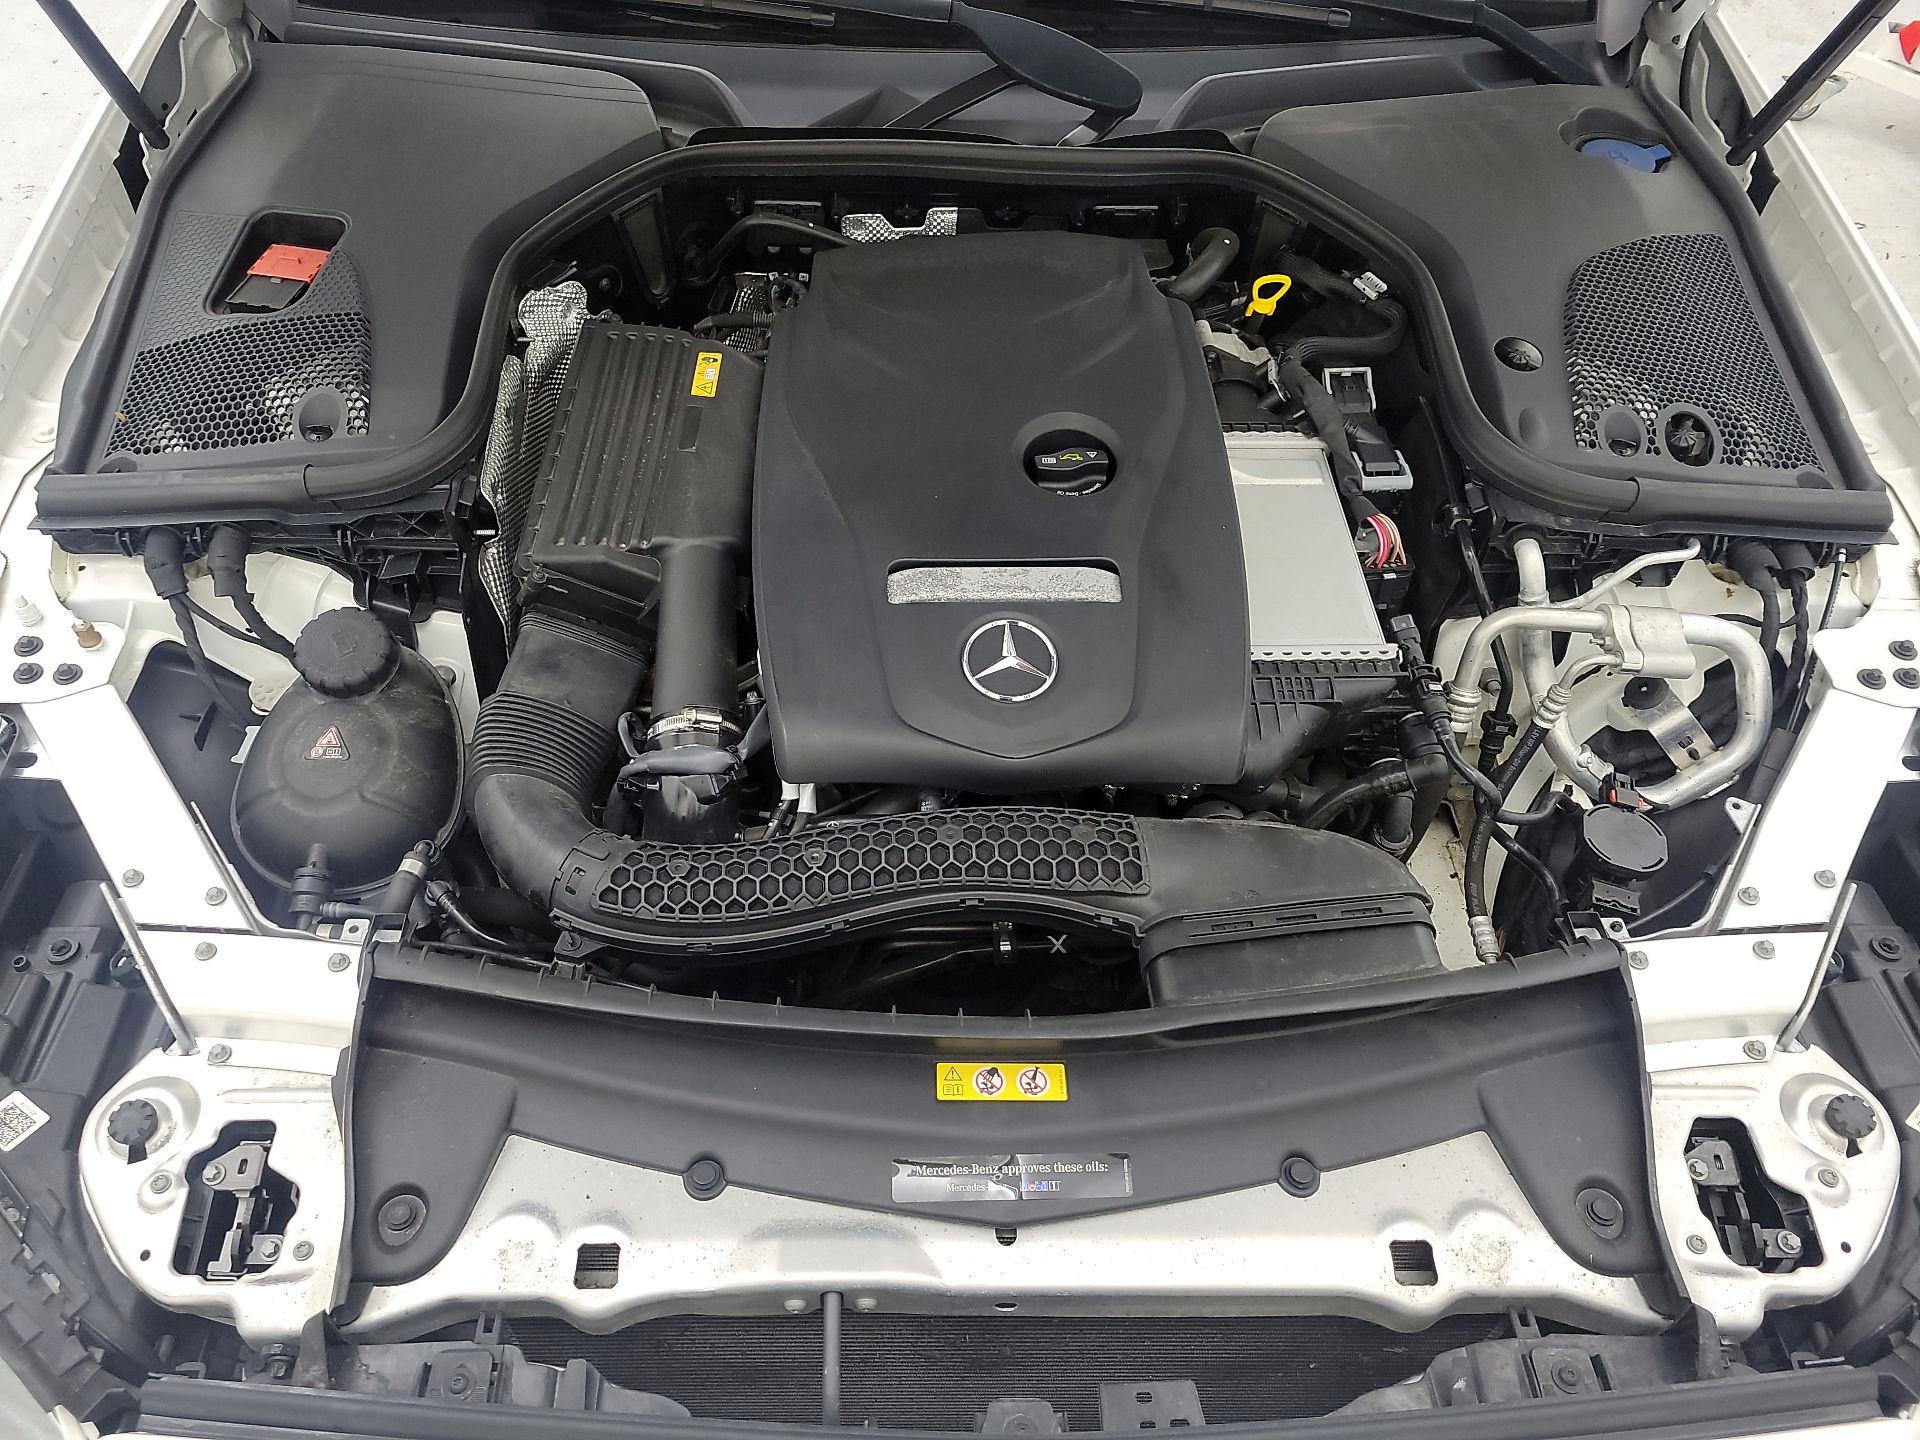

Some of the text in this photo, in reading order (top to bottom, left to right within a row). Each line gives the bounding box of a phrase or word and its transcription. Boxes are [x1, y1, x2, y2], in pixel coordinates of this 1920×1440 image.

[915, 1160, 1109, 1177] Mercedes-Benz approves these oils:
[946, 1182, 1006, 1194] Mercedes-
